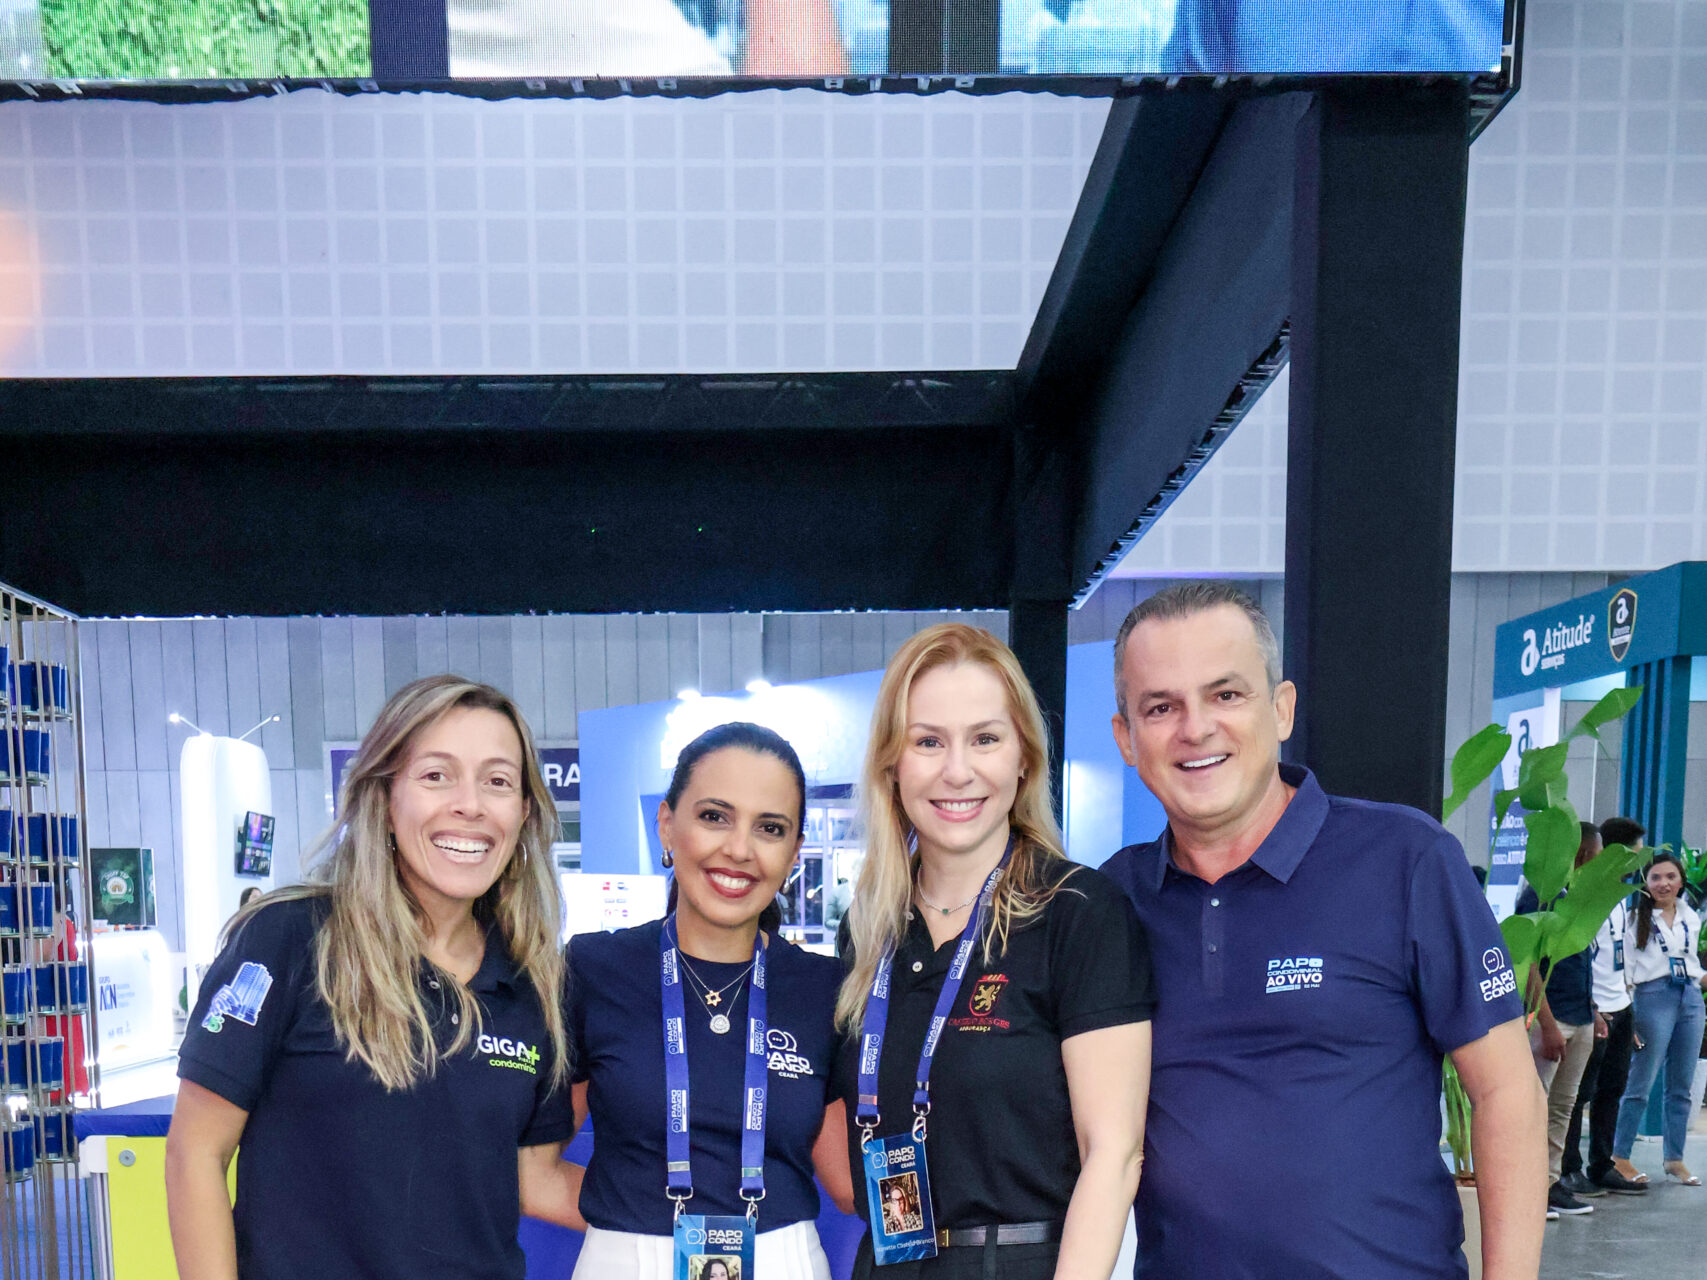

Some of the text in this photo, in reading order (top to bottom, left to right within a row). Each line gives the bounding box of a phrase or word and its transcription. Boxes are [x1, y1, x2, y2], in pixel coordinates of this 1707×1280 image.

[1541, 614, 1592, 656] Atitude
[954, 940, 967, 966] PAPO
[1268, 958, 1324, 970] PAPO
[1266, 972, 1322, 988] AO VIVO
[1480, 969, 1514, 994] PAPO
[1484, 980, 1516, 1002] CONDO
[928, 1016, 939, 1043] PAPO
[766, 1062, 814, 1075] ONDO
[870, 1048, 878, 1074] PAPO
[888, 1146, 914, 1158] PAPO
[888, 1153, 916, 1165] CONDO
[708, 1230, 744, 1238] PAPO
